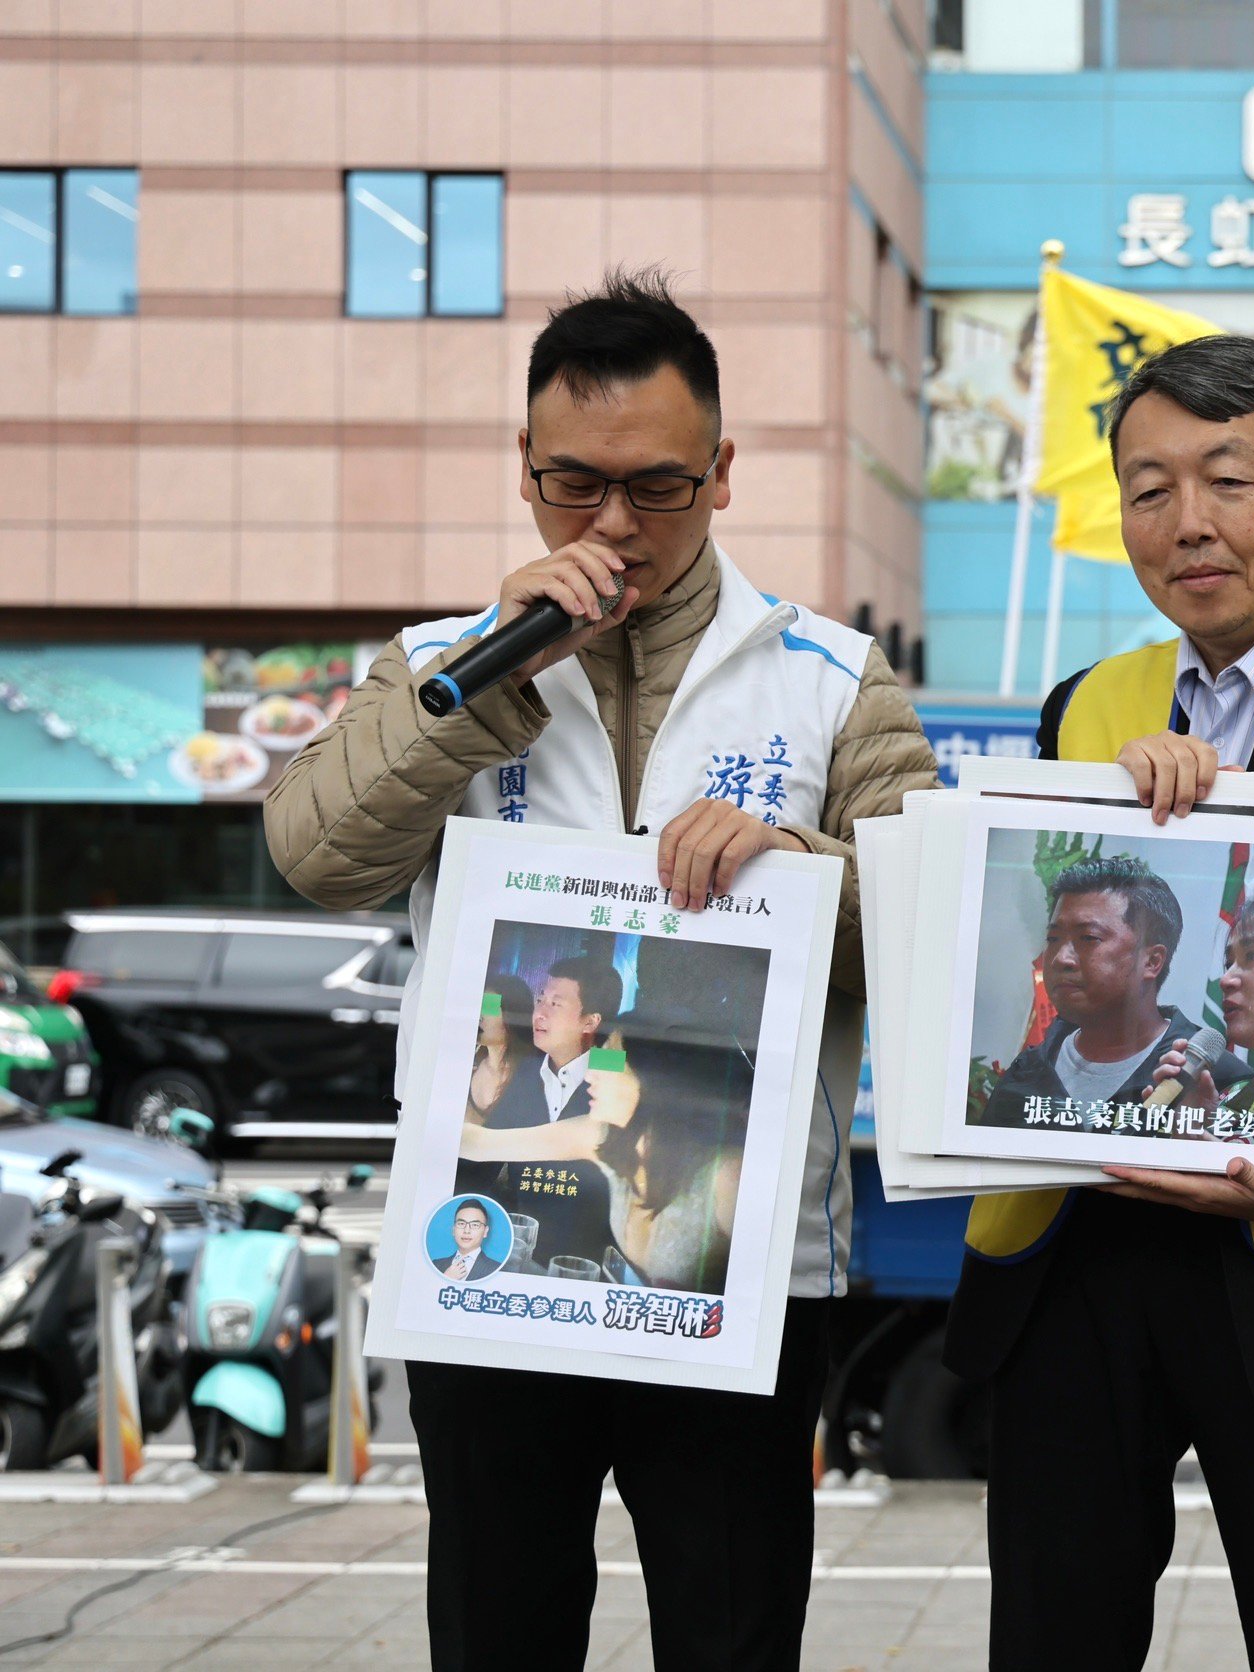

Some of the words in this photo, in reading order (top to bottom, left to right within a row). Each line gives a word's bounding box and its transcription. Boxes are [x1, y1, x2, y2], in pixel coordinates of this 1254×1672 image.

[498, 748, 528, 823] 園市
[590, 905, 681, 934] 張志豪
[519, 1180, 578, 1197] 游智彬提供
[439, 1286, 597, 1325] 中壢立委參選人
[603, 1289, 724, 1339] 游智彬
